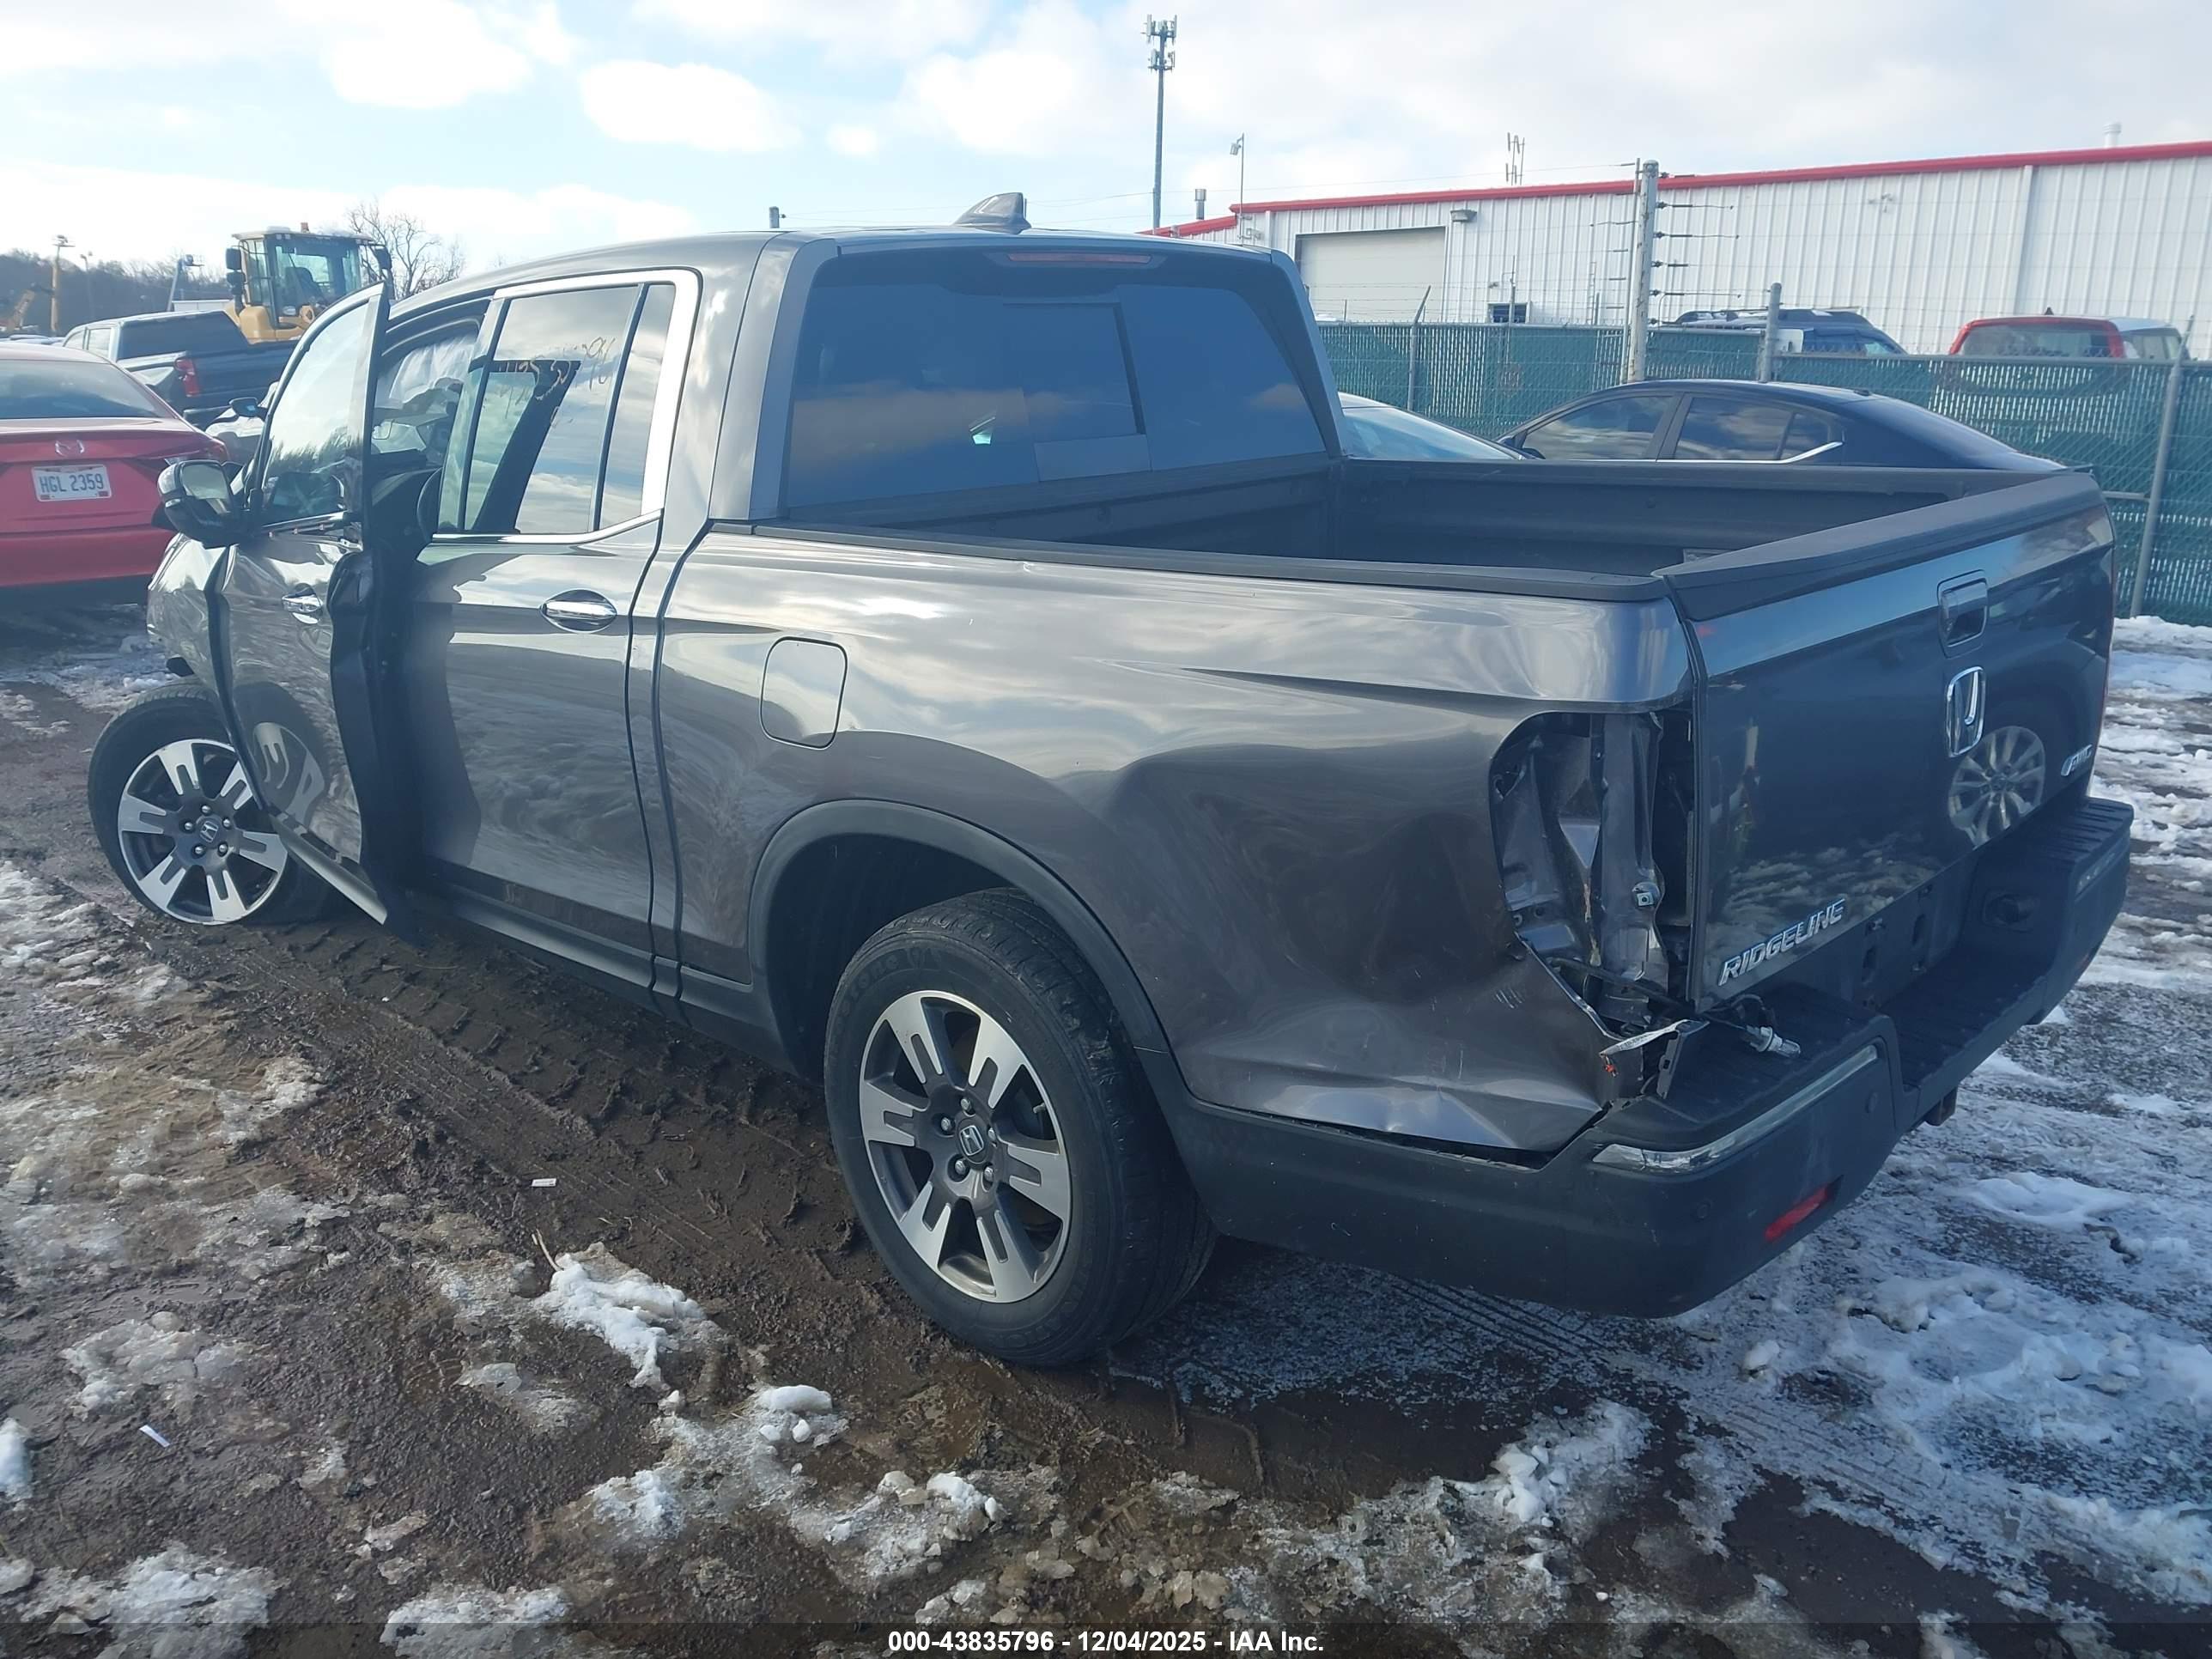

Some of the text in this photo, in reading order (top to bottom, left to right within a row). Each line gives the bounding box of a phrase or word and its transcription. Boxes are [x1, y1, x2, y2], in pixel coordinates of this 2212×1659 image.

[40, 473, 104, 493] HGL 2359
[1718, 898, 1845, 987] RIDGELINE
